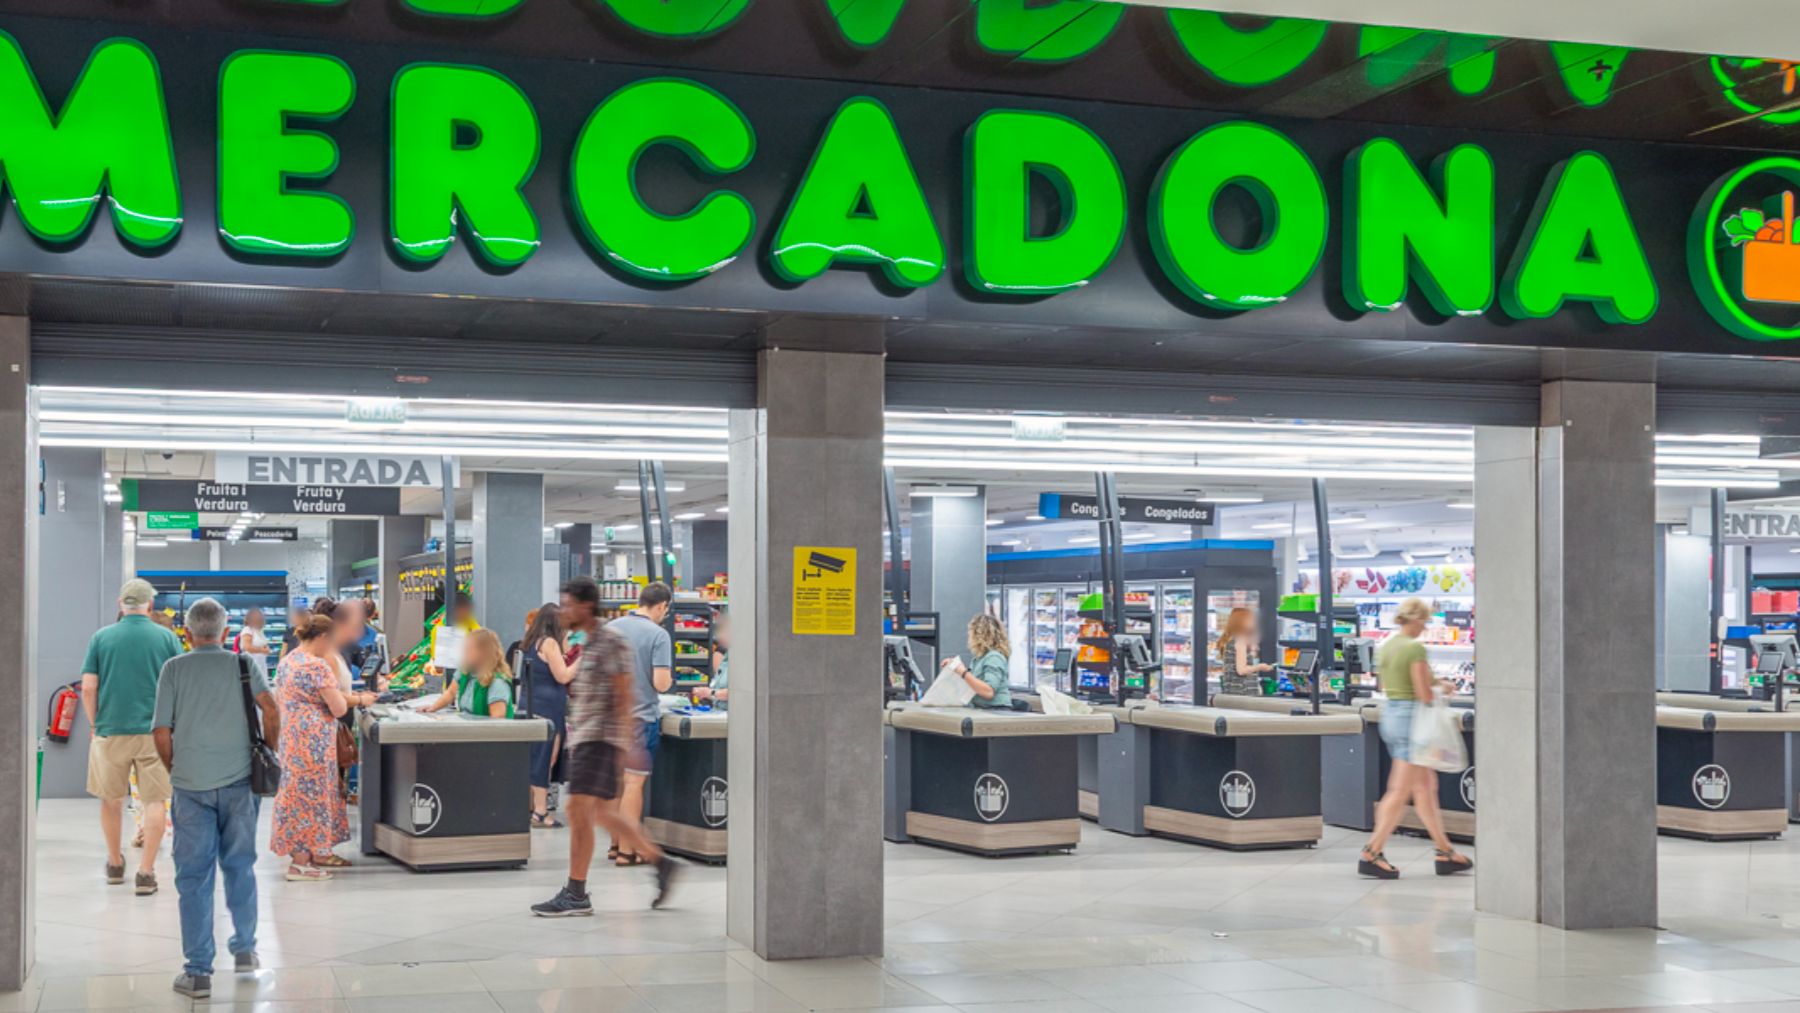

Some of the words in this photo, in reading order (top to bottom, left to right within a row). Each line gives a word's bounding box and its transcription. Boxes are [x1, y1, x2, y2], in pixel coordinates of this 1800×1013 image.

[0, 28, 1660, 325] MERCADONA
[248, 456, 431, 485] ENTRADA
[197, 483, 239, 496] Fruita
[241, 483, 246, 496] i
[297, 485, 332, 498] Fruta
[334, 488, 344, 500] y
[194, 498, 248, 511] Verdura
[293, 499, 346, 513] Verdura
[1071, 502, 1126, 517] Congs
[1145, 505, 1208, 520] Congelados
